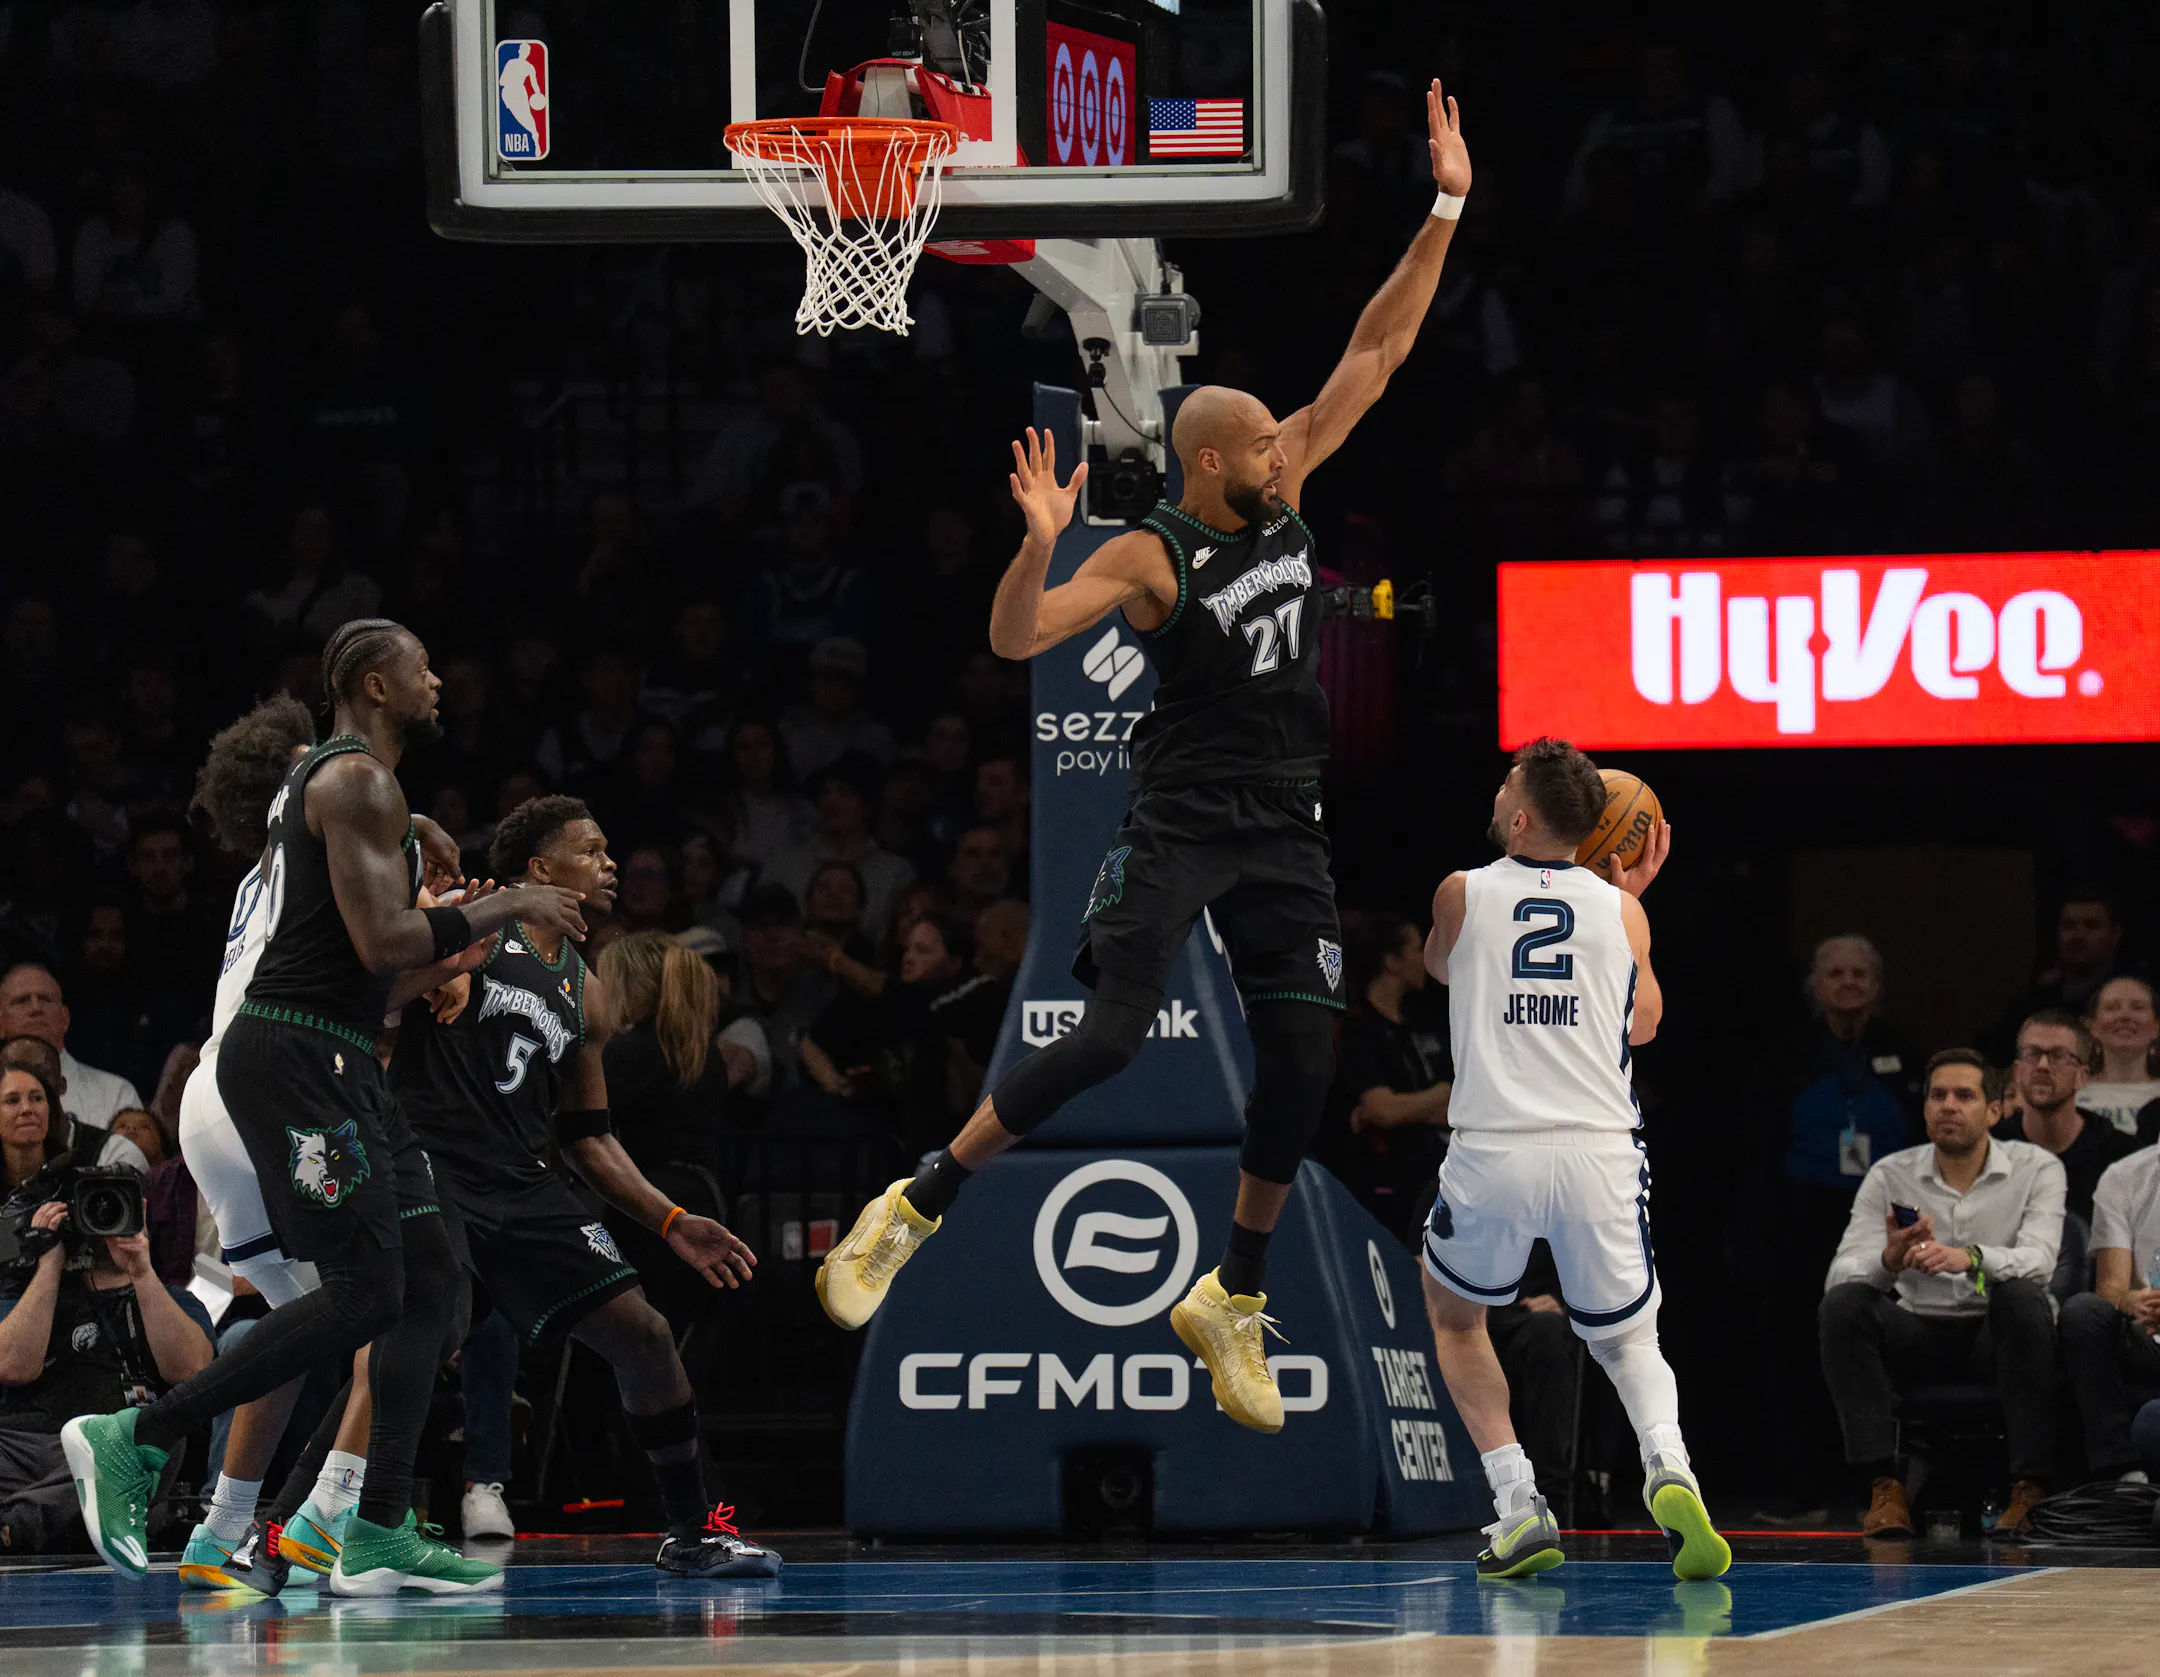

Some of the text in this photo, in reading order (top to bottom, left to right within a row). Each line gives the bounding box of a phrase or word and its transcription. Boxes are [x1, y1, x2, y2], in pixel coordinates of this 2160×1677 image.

[504, 133, 530, 153] NBA
[1195, 546, 1211, 561] NIKE
[1262, 515, 1289, 537] sezzle
[1198, 543, 1313, 638] TIMBERWOLVES
[1241, 594, 1305, 677] 27
[1056, 750, 1113, 776] pay
[508, 938, 524, 951] NIKE
[1511, 896, 1575, 981] 2
[478, 973, 579, 1064] TIMBERWOLVES
[1503, 993, 1580, 1027] JEROME
[494, 1031, 544, 1095] 5
[1371, 1346, 1437, 1411] TARGET
[1390, 1418, 1454, 1482] CENTER
